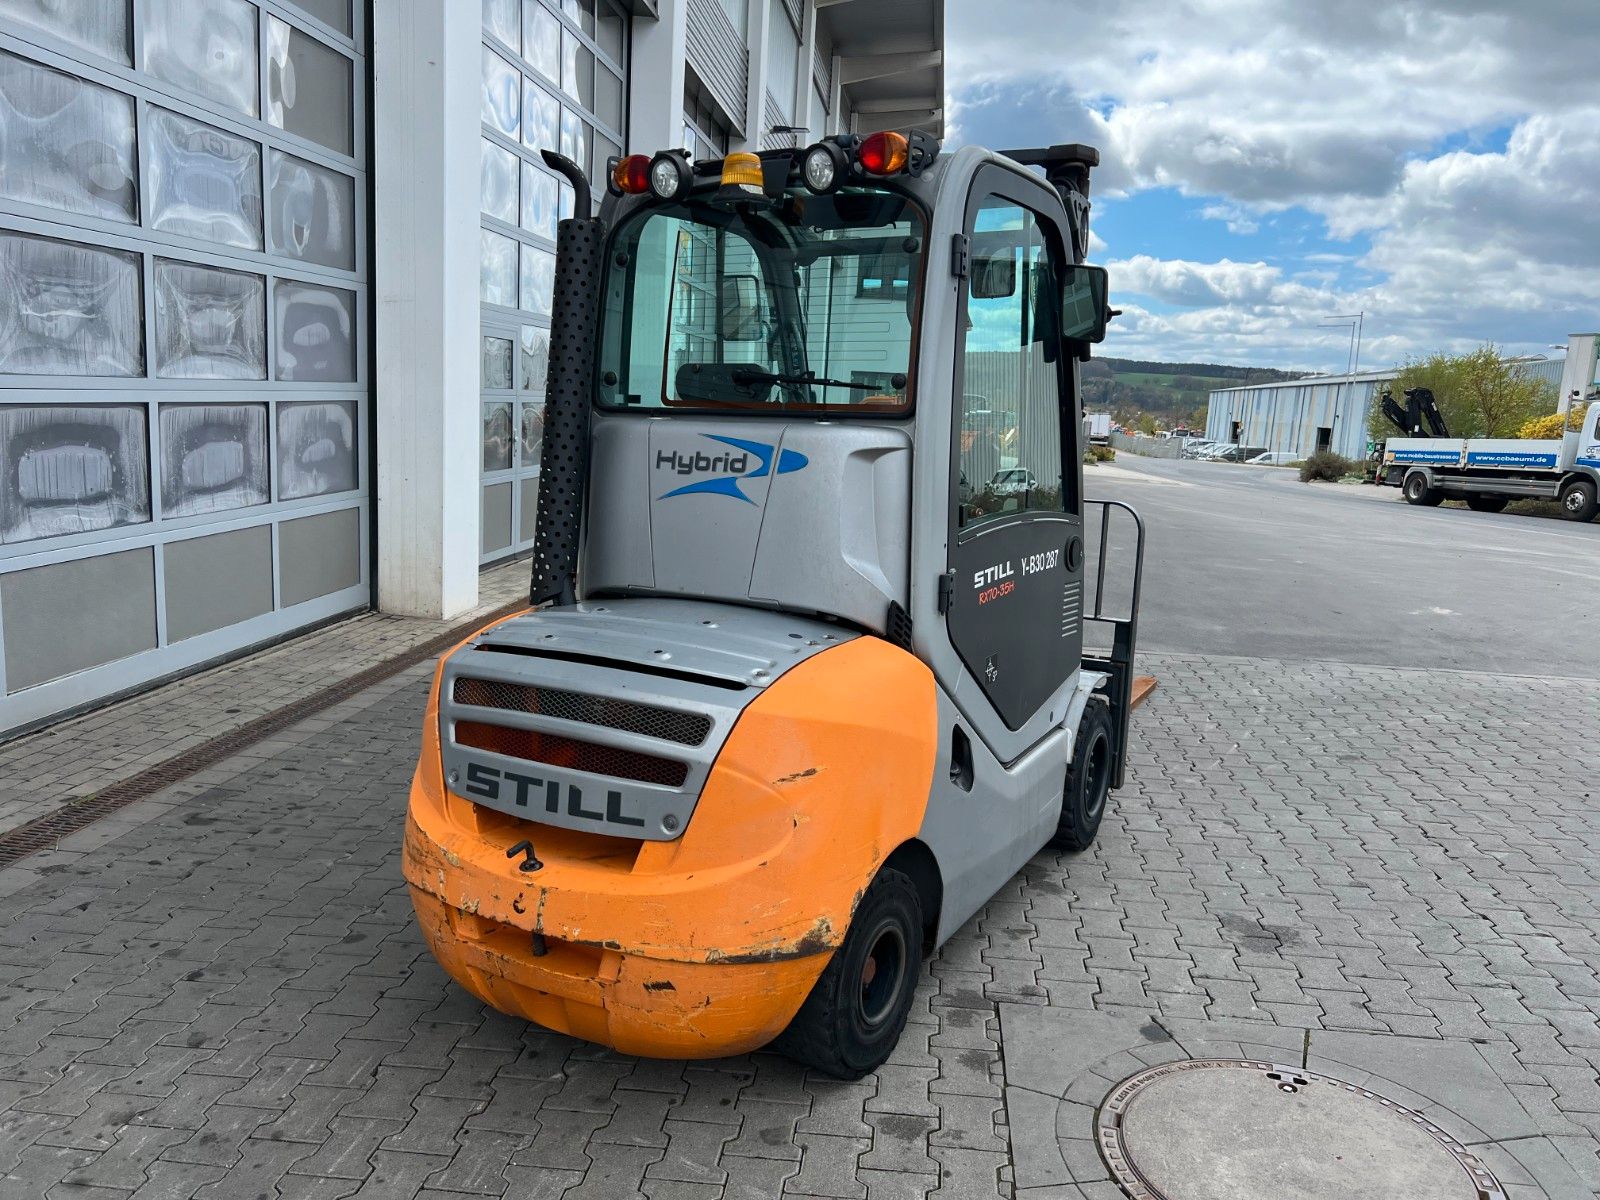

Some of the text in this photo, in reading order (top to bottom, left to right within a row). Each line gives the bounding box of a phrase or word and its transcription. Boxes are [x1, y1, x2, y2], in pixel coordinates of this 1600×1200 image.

[656, 450, 748, 475] Hybrid
[974, 560, 1015, 589] STILL
[1021, 549, 1059, 576] Y-B30 287
[979, 580, 1015, 605] RX70-35H
[466, 762, 645, 827] STILL
